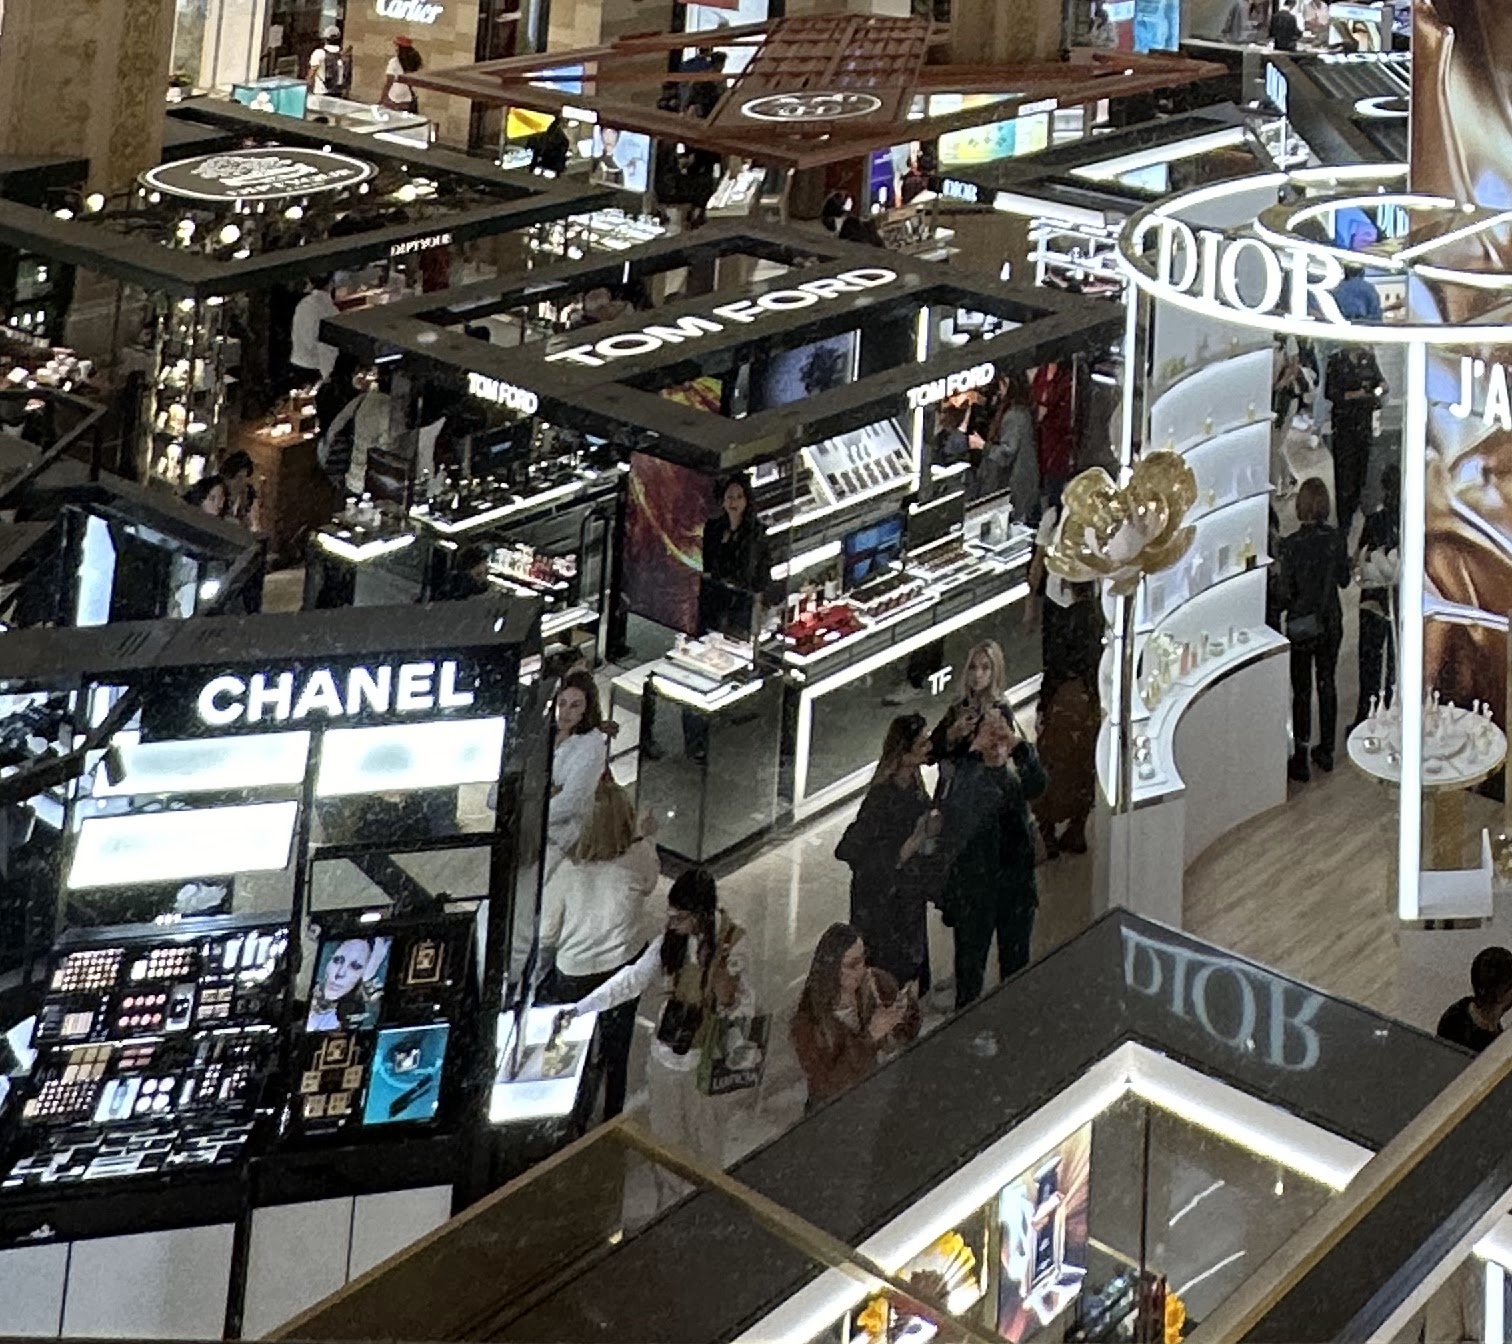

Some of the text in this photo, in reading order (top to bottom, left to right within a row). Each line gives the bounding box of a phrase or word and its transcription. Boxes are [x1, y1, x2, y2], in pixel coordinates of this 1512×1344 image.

[1155, 214, 1351, 325] DIOR
[545, 267, 898, 367] TOM FORD
[467, 372, 539, 414] TOM FORD
[907, 362, 995, 410] TOM FORD
[196, 660, 476, 724] CHANEL
[927, 666, 953, 696] TF
